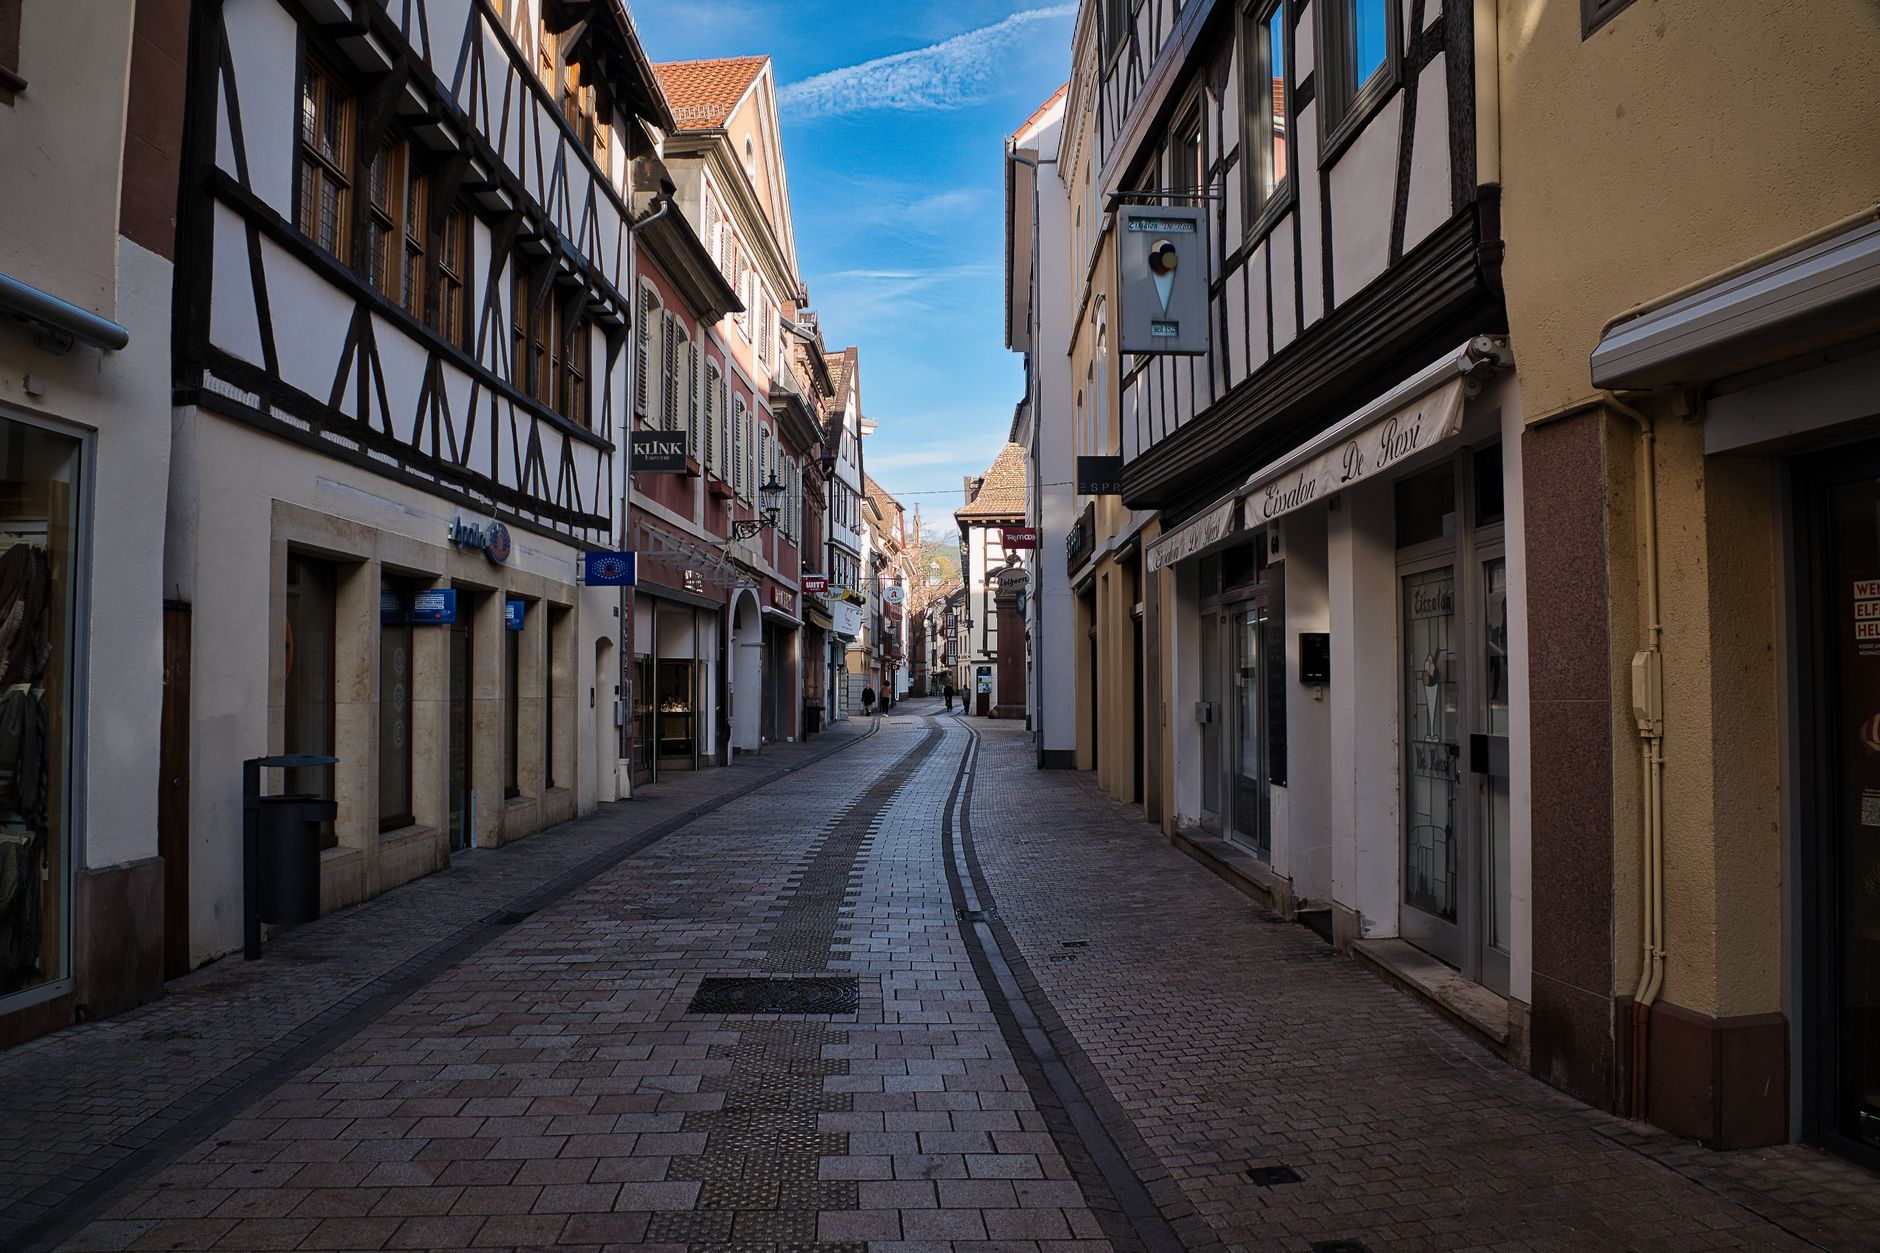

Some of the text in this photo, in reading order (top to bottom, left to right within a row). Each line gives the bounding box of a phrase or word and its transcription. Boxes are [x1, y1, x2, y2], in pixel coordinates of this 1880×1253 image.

[633, 440, 683, 455] KLINK
[1263, 413, 1422, 518] Eissalon De Rossi
[806, 581, 825, 589] WITT
[1857, 603, 1880, 617] ELF
